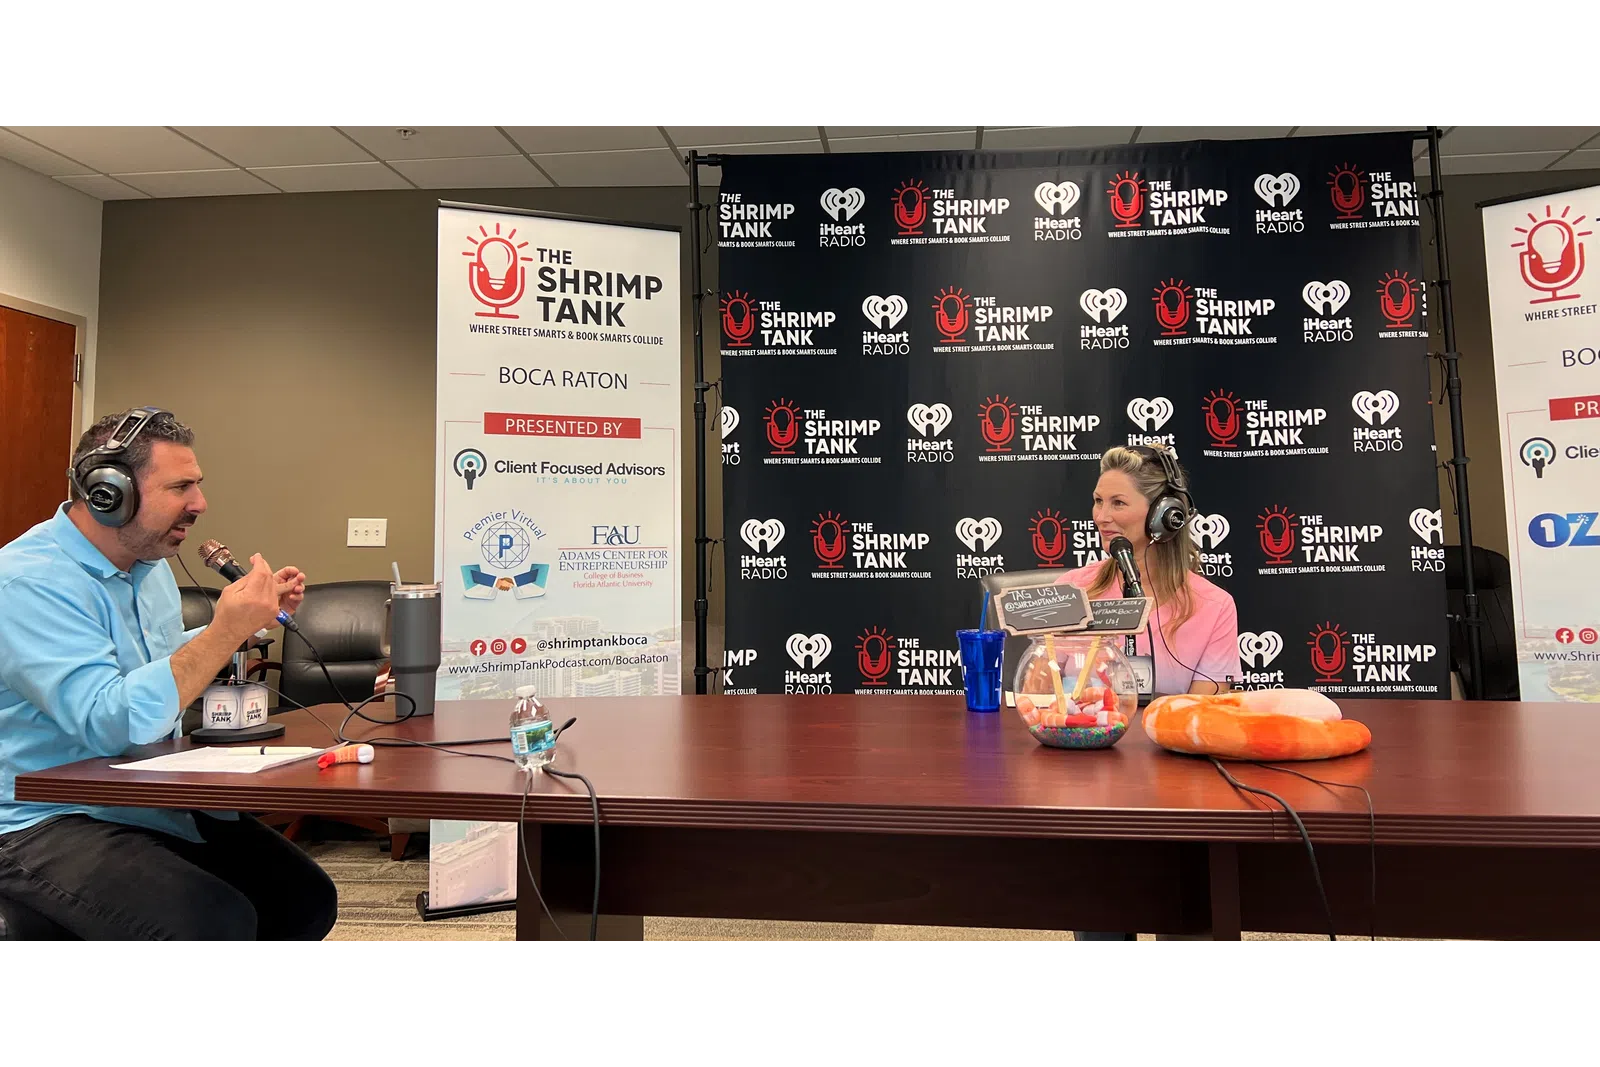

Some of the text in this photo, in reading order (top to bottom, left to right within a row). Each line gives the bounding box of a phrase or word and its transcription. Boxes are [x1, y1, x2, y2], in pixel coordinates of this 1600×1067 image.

[1369, 172, 1392, 182] THE
[1148, 180, 1171, 191] THE
[1371, 181, 1417, 199] SHRI
[720, 193, 741, 203] THE
[932, 189, 954, 199] THE
[1150, 188, 1228, 208] SHRIMP
[720, 204, 795, 220] SHRIMP
[932, 198, 1010, 217] SHRIMP
[1034, 216, 1081, 229] iHeart
[1149, 206, 1206, 226] TANK
[1256, 209, 1303, 222] iHeart
[719, 221, 772, 238] TANK
[820, 223, 865, 235] iHeart
[932, 217, 987, 234] TANK
[1209, 227, 1230, 235] COLLIDE
[1256, 221, 1304, 234] RADIO
[820, 235, 866, 247] RADIO
[1034, 228, 1082, 241] RADIO
[537, 248, 572, 265] THE
[537, 266, 663, 300] SHRIMP
[1194, 288, 1217, 299] THE
[759, 301, 781, 311] THE
[973, 296, 996, 307] THE
[1196, 298, 1275, 317] SHRIMP
[537, 296, 626, 327] TANK
[975, 306, 1053, 324] SHRIMP
[1524, 304, 1597, 322] WHERE STREET
[761, 311, 836, 328] SHRIMP
[1196, 317, 1252, 335] TANK
[1303, 317, 1352, 331] iHeart
[469, 324, 663, 345] WHERE STREET SMARTS & BOOK SMARTS COLLIDE
[760, 330, 814, 346] TANK
[863, 331, 909, 343] iHeart
[974, 324, 1030, 342] TANK
[1080, 324, 1129, 338] iHeart
[1304, 329, 1353, 343] RADIO
[863, 343, 910, 355] RADIO
[1081, 337, 1130, 350] RADIO
[1562, 347, 1600, 367] BO
[499, 366, 628, 390] BOCA RATON
[1020, 405, 1043, 415] THE
[1245, 400, 1268, 410] THE
[804, 409, 825, 419] THE
[1246, 408, 1327, 428] SHRIMP
[505, 418, 622, 435] PRESENTED BY
[805, 420, 881, 437] SHRIMP
[1021, 415, 1100, 433] SHRIMP
[1127, 433, 1175, 447] iHeart
[1246, 428, 1304, 447] TANK
[1353, 427, 1402, 440] iHeart
[804, 438, 858, 454] TANK
[907, 438, 953, 451] iHeart
[1021, 434, 1077, 451] TANK
[1354, 439, 1403, 452] RADIO
[907, 451, 954, 462] RADIO
[1565, 445, 1600, 459] Clie
[494, 460, 665, 476] Client Focused Advisors
[463, 509, 546, 541] Premier Virtual
[851, 523, 873, 532] THE
[1072, 520, 1094, 530] THE
[1299, 515, 1323, 526] THE
[591, 525, 641, 546] FAU
[852, 533, 930, 550] SHRIMP
[1301, 525, 1383, 544] SHRIMP
[499, 534, 513, 559] P
[1410, 546, 1445, 559] iHea
[558, 549, 668, 561] ADAMS CENTER FOR
[852, 552, 907, 568] TANK
[956, 554, 1004, 567] iHeart
[1301, 545, 1360, 563] TANK
[559, 560, 668, 571] ENTREPRENEURSHIP
[741, 555, 787, 568] iHeart
[1411, 560, 1446, 572] RAD
[583, 572, 606, 580] College
[617, 571, 644, 579] Business
[741, 568, 787, 580] RADIO
[1198, 564, 1233, 577] ADIO
[596, 580, 621, 588] Atlantic
[622, 580, 653, 588] University
[1008, 590, 1032, 601] TAG
[537, 634, 648, 651] @shrimptankboca
[897, 638, 919, 648] THE
[1351, 633, 1375, 644] THE
[898, 650, 962, 667] SHRIM
[1353, 644, 1436, 663] SHRIMP
[449, 654, 669, 675] www.ShrimpTankPodcast.com/BocaRaton
[785, 670, 831, 684] iHeart
[897, 668, 952, 686] TANK
[1242, 670, 1284, 684] Heart
[1352, 664, 1411, 682] TANK
